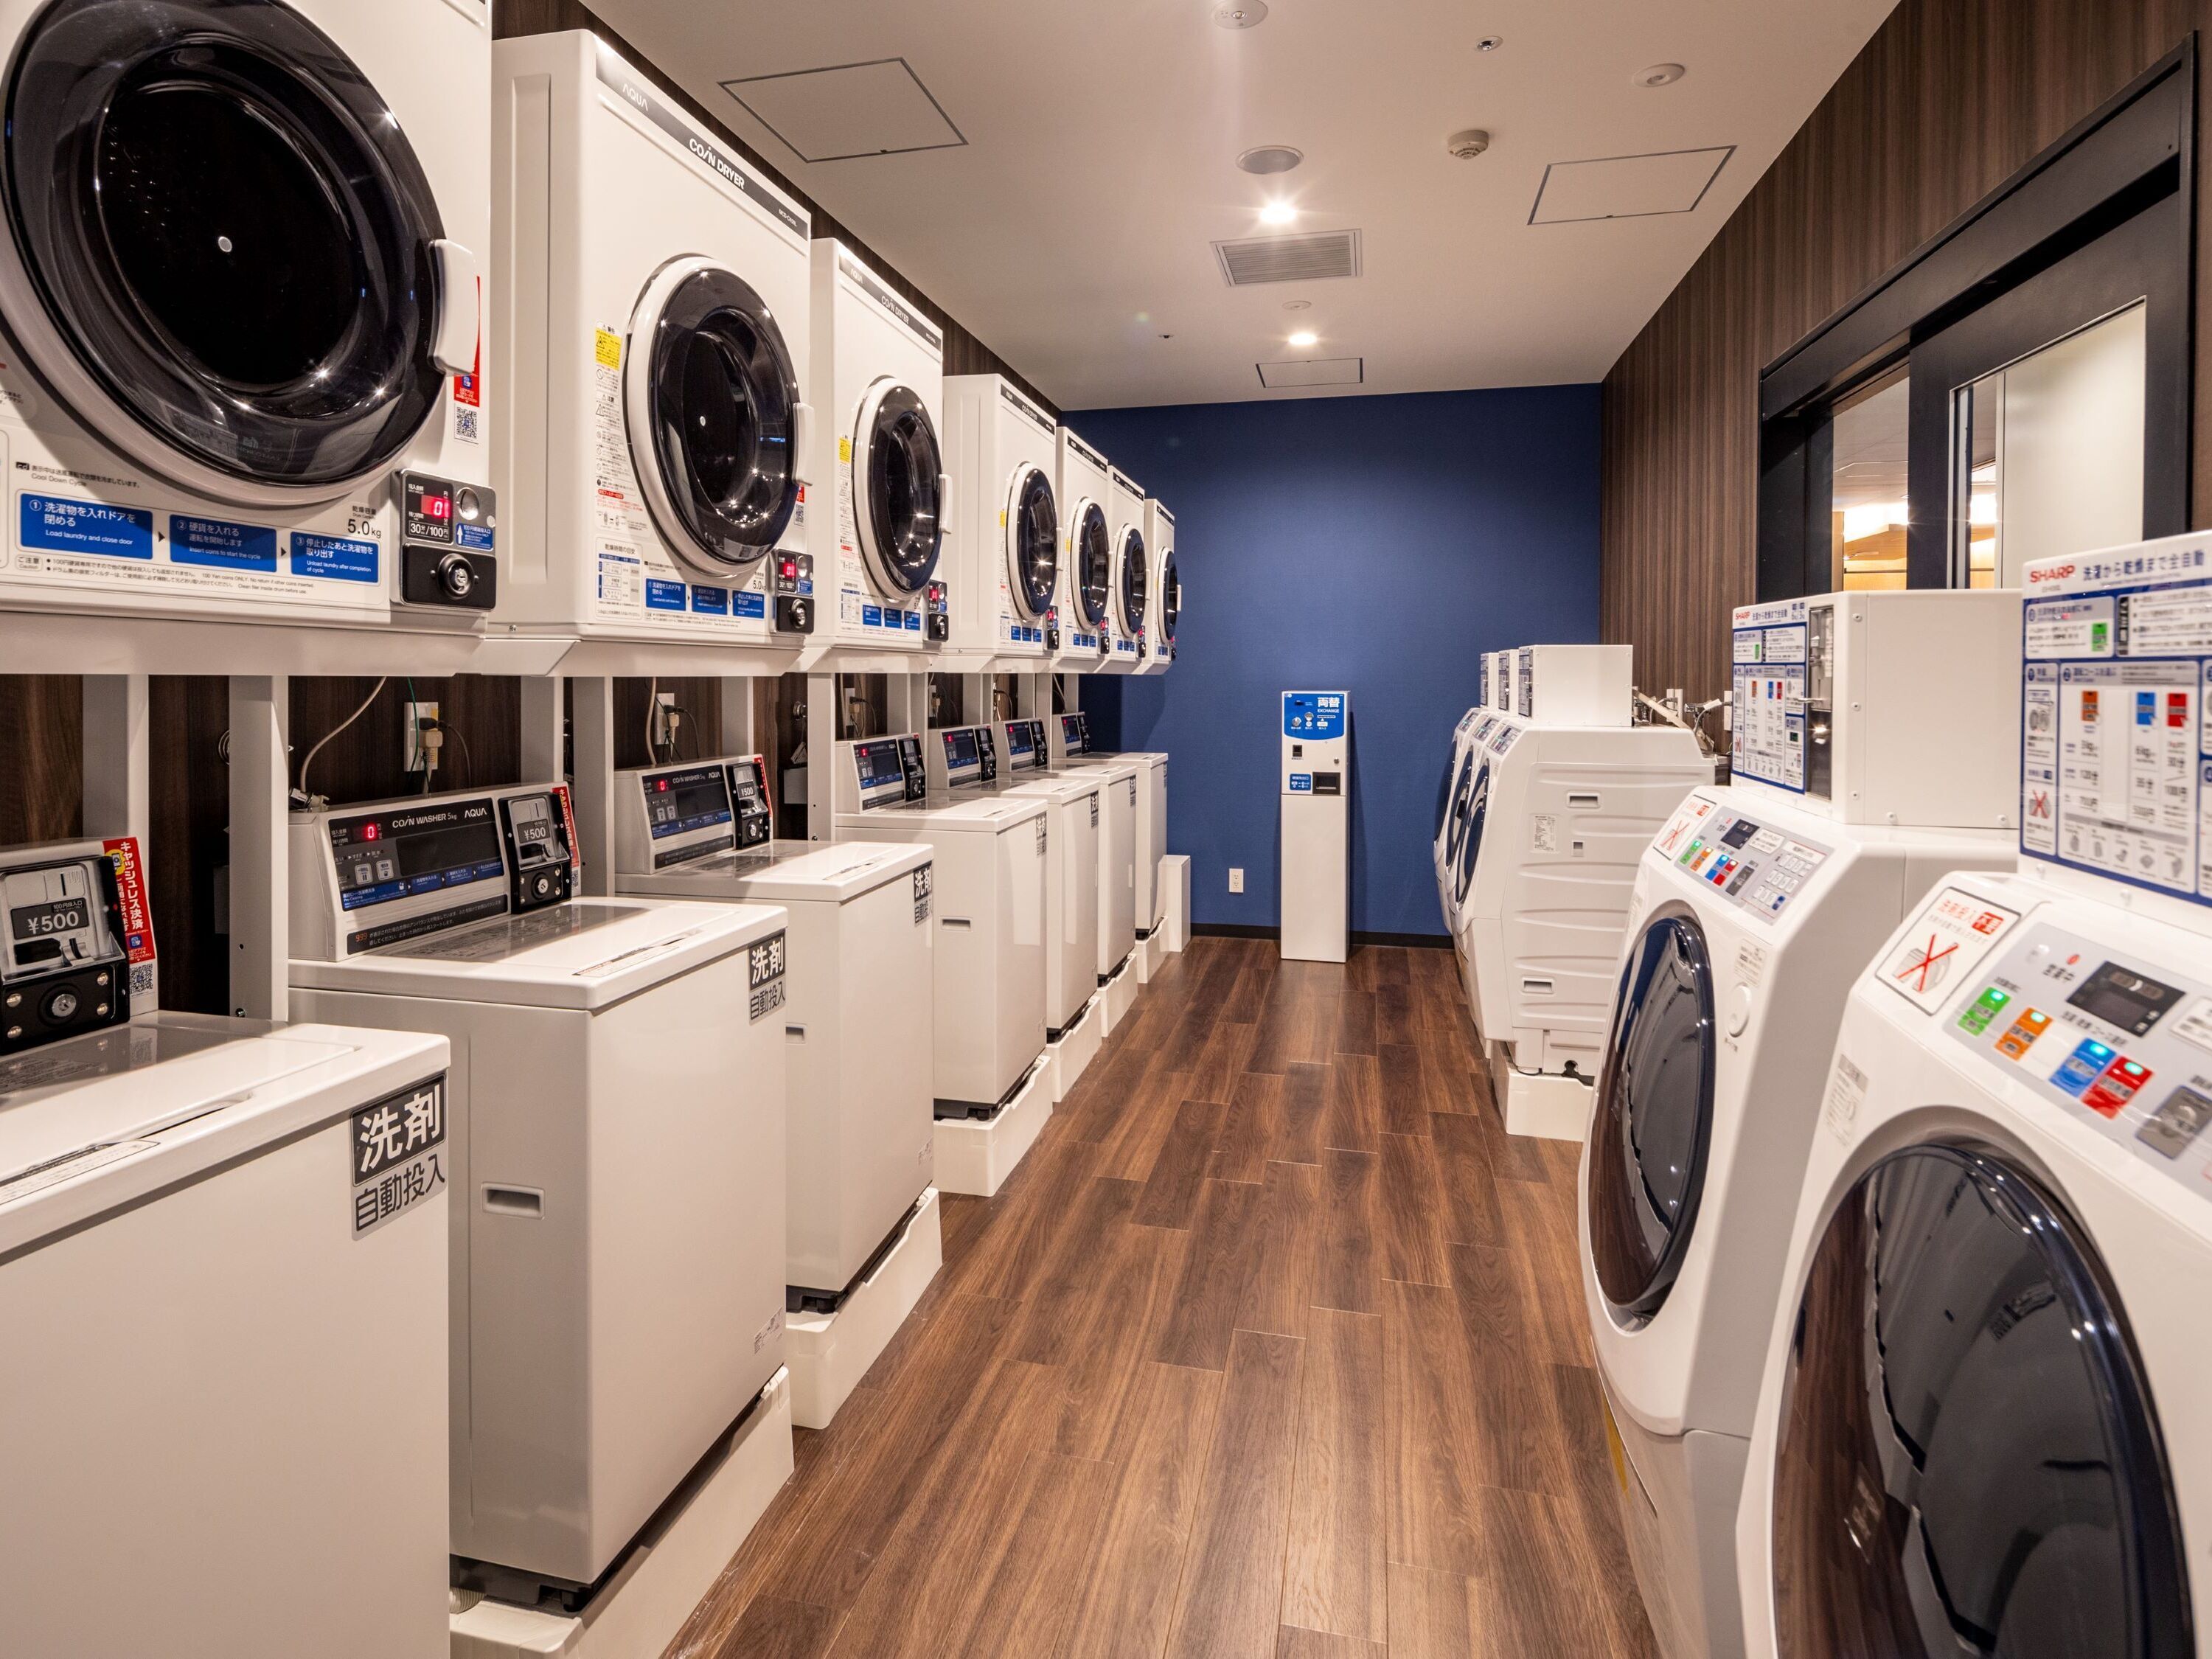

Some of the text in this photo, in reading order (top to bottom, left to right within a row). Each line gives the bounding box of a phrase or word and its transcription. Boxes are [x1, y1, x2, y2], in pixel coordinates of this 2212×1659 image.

[623, 83, 648, 111] AQUA
[717, 159, 745, 189] DRYER
[32, 473, 46, 481] Cool
[44, 501, 136, 523] 洗濯物を入れドアを
[44, 514, 76, 526] 閉める
[63, 531, 87, 541] laundry
[189, 522, 239, 536] 硬貨を入れる
[347, 518, 381, 538] 5.0 kg
[189, 534, 243, 547] 運転を開始します
[306, 538, 373, 554] 停止したあと洗濯物を
[307, 548, 334, 558] 取り出す
[2030, 565, 2076, 583] SHARP
[1318, 697, 1340, 707] 両替
[416, 813, 446, 824] WASHER
[464, 807, 487, 818] AQUA
[368, 826, 375, 838] 0
[524, 827, 546, 841] ¥500
[120, 841, 144, 930] キャッシュレス決済
[914, 866, 931, 898] 洗剤
[27, 911, 79, 934] ¥500
[751, 936, 784, 984] 洗剤
[750, 981, 785, 1020] 自動投入
[360, 1084, 440, 1173] 洗剤
[355, 1153, 445, 1231] 自動投入
